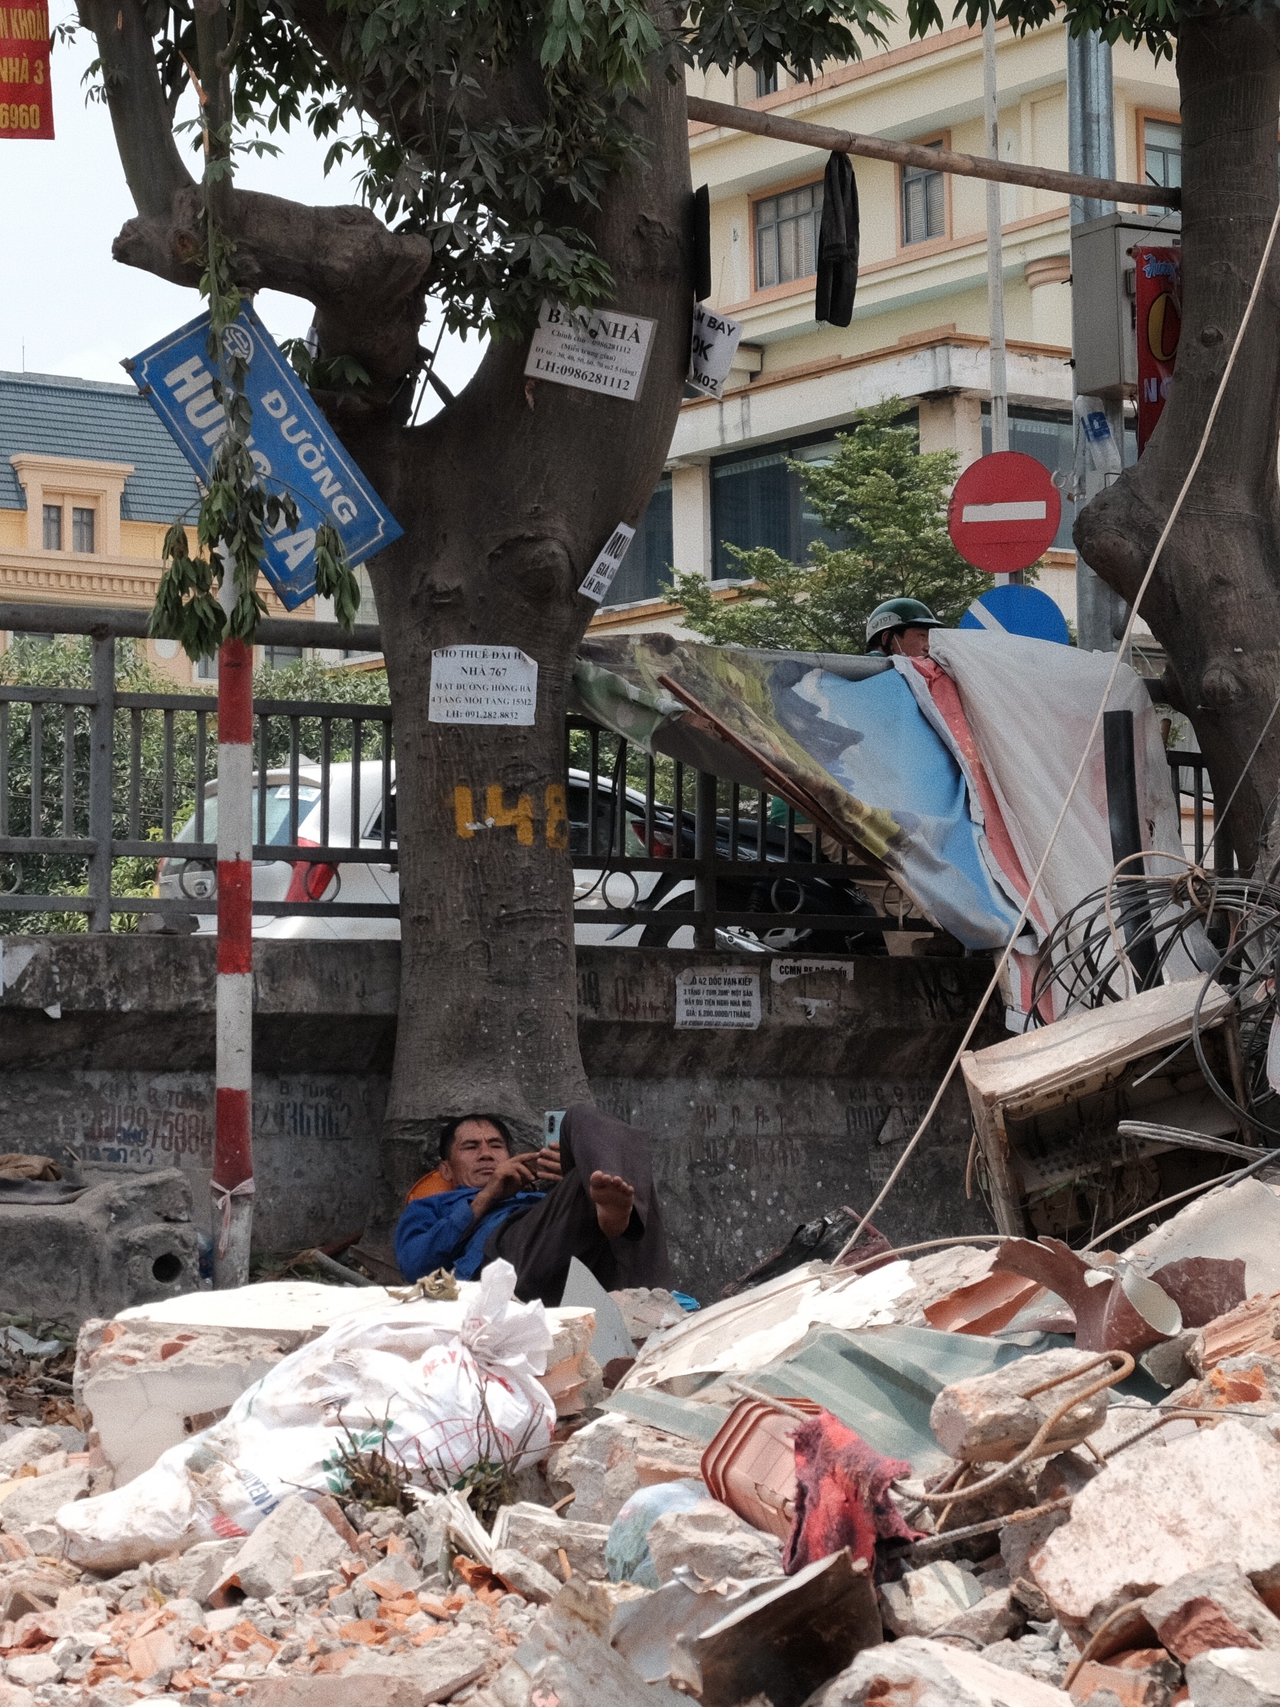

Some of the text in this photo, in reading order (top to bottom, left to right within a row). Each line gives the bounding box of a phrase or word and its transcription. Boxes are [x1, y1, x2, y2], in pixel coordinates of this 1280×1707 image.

[10, 3, 48, 42] KHOÁI
[33, 59, 44, 85] 3
[598, 318, 640, 344] NHÀ
[707, 315, 736, 336] BAY
[535, 358, 630, 391] LH:0986281112
[261, 387, 359, 526] ĐƯỜNG
[514, 651, 527, 662] H
[461, 664, 507, 677] NHÀ 767
[446, 710, 462, 719] LH:
[779, 964, 801, 975] CCMN
